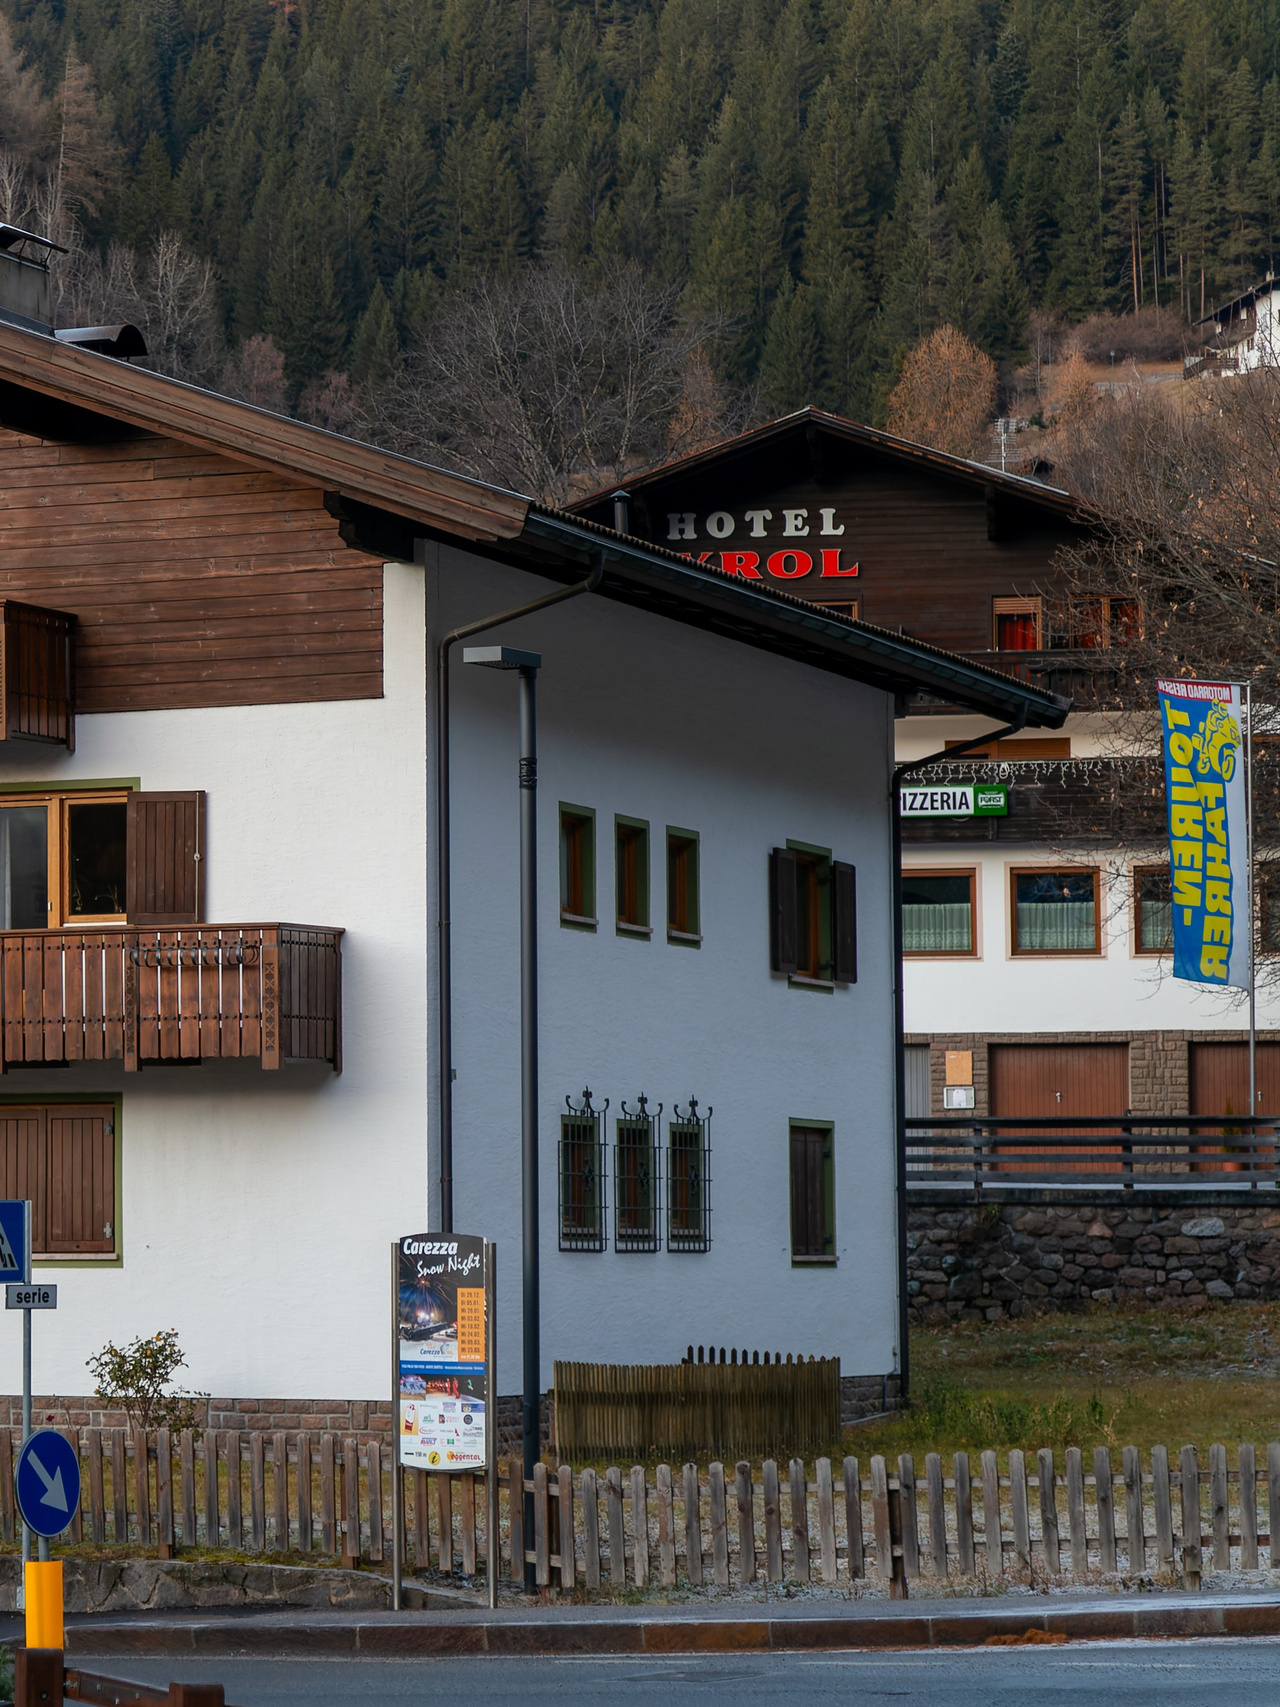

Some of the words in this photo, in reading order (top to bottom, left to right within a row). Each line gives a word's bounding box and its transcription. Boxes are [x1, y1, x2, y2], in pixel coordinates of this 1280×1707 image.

[667, 508, 845, 540] HOTEL
[900, 791, 970, 811] IZZERIA
[403, 1238, 458, 1255] Carezza
[417, 1261, 445, 1278] Snow
[448, 1253, 480, 1276] Night
[16, 1287, 50, 1304] serie
[451, 1454, 481, 1462] eggental
